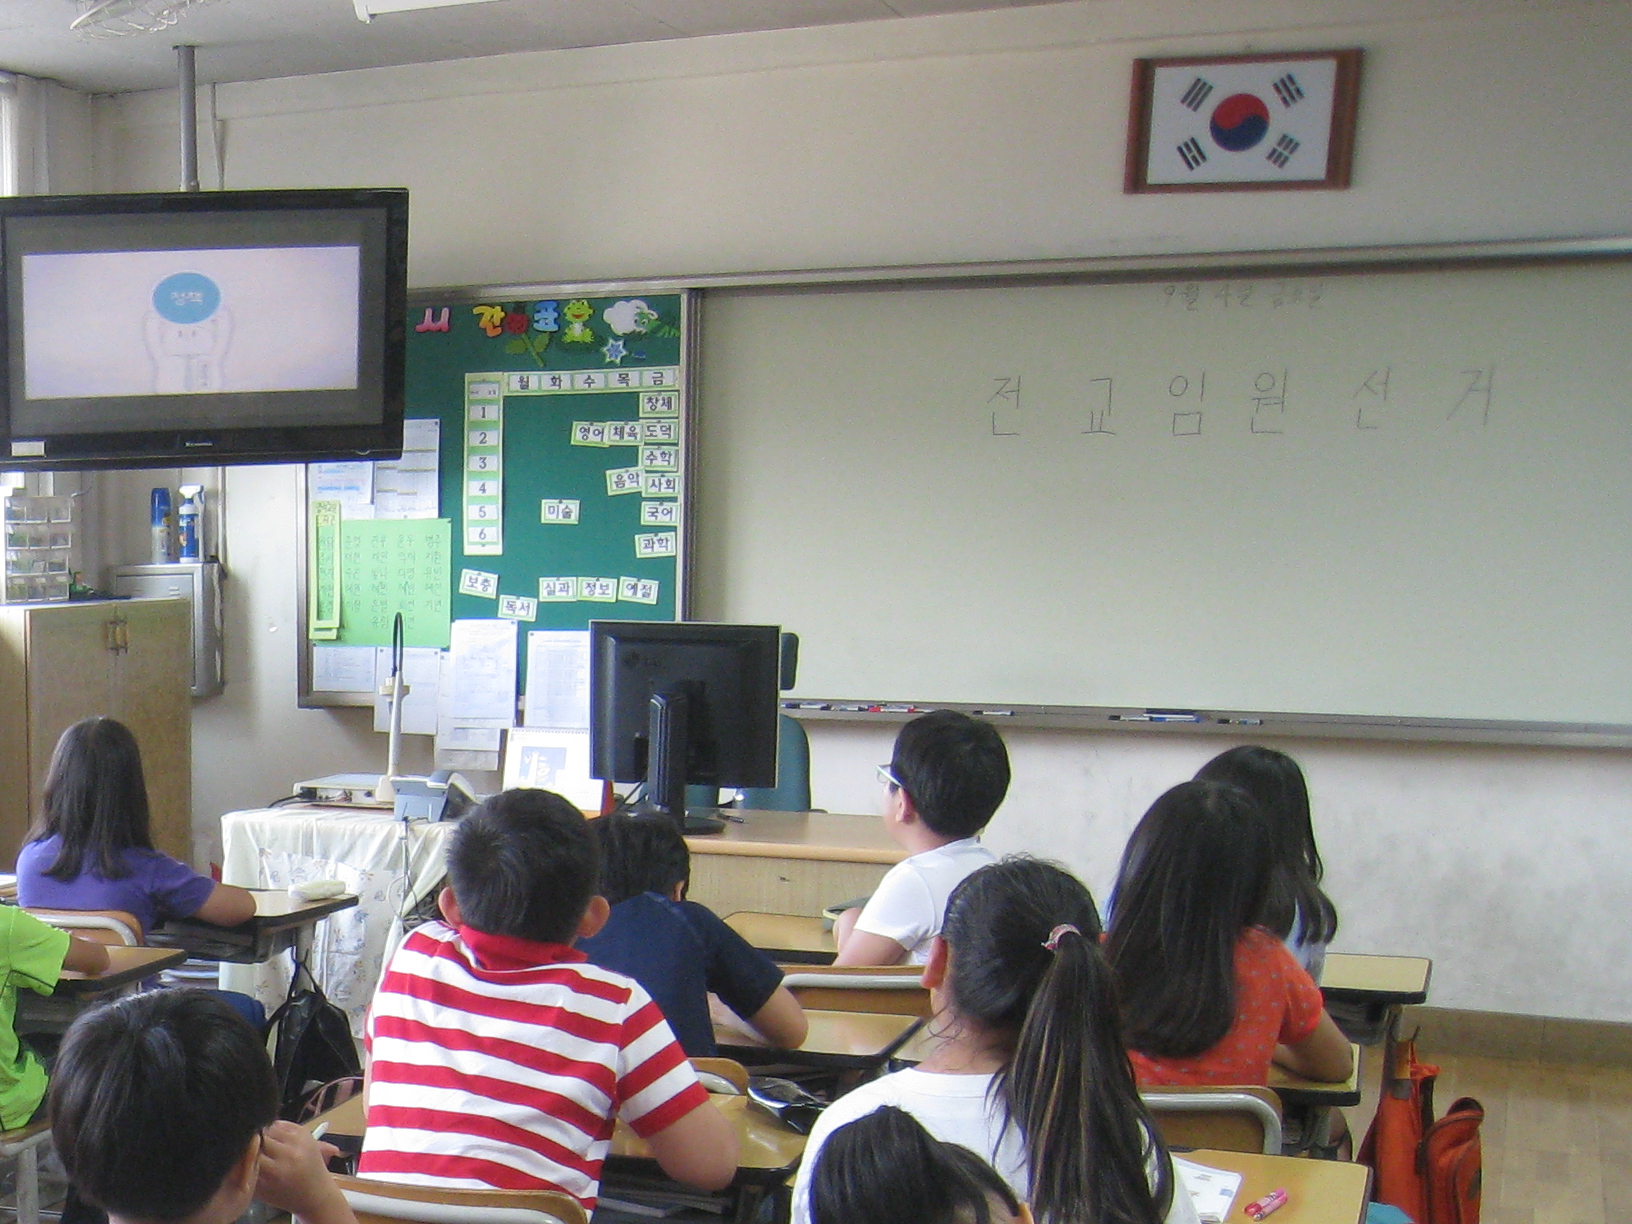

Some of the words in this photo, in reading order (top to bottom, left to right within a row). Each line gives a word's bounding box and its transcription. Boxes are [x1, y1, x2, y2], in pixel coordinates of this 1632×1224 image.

[518, 375, 530, 390] 월
[550, 376, 563, 391] 화
[583, 374, 597, 389] 수
[617, 373, 630, 388] 목
[651, 371, 665, 386] 금
[481, 407, 487, 419] 1
[479, 432, 487, 445] 2
[579, 426, 605, 441] 영어
[614, 425, 639, 440] 체육
[645, 424, 672, 439] 도덕
[479, 457, 487, 470] 3
[645, 450, 673, 466] 수학
[614, 471, 641, 488] 음악
[649, 477, 676, 493] 사회
[479, 482, 487, 494] 4
[479, 506, 486, 519] 5
[646, 506, 673, 521] 국어
[479, 528, 486, 541] 6
[642, 537, 670, 552] 과학
[544, 582, 571, 596] 실과
[584, 582, 610, 596] 정보
[505, 600, 531, 615] 독서
